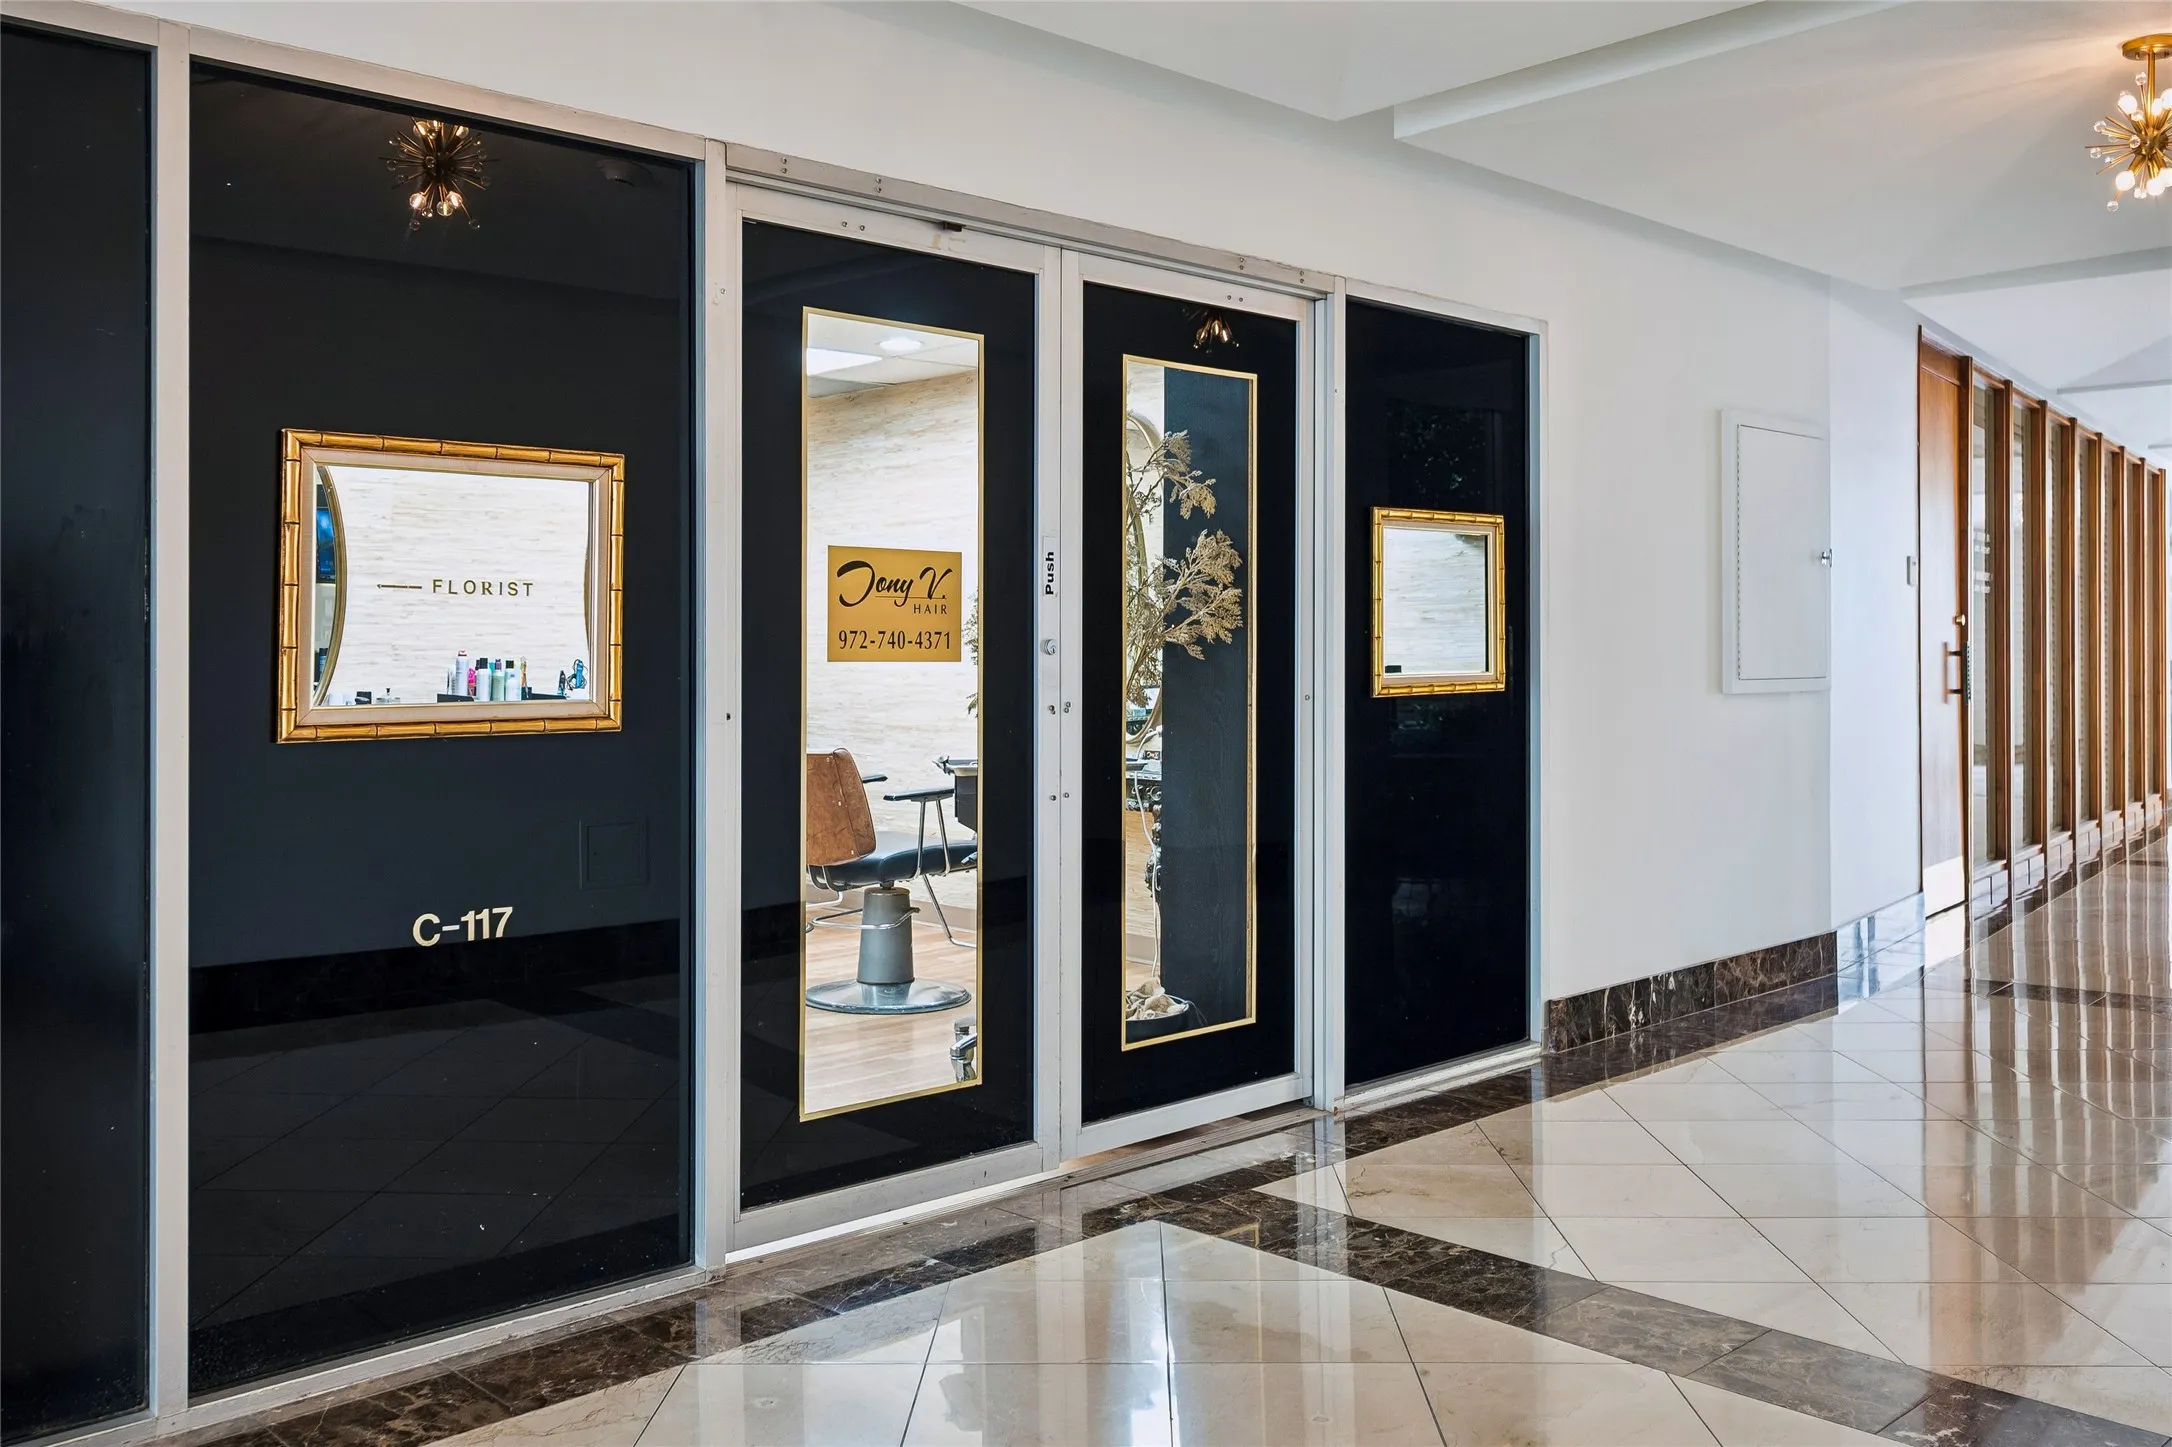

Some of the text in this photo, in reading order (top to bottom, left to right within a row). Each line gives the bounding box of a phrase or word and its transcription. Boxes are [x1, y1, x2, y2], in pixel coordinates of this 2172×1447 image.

[919, 566, 953, 600] V.
[1045, 551, 1055, 595] Push
[432, 579, 534, 597] FLORIST
[913, 603, 948, 615] HAIR
[838, 630, 951, 650] 972-740-4371
[412, 906, 513, 947] C-117
